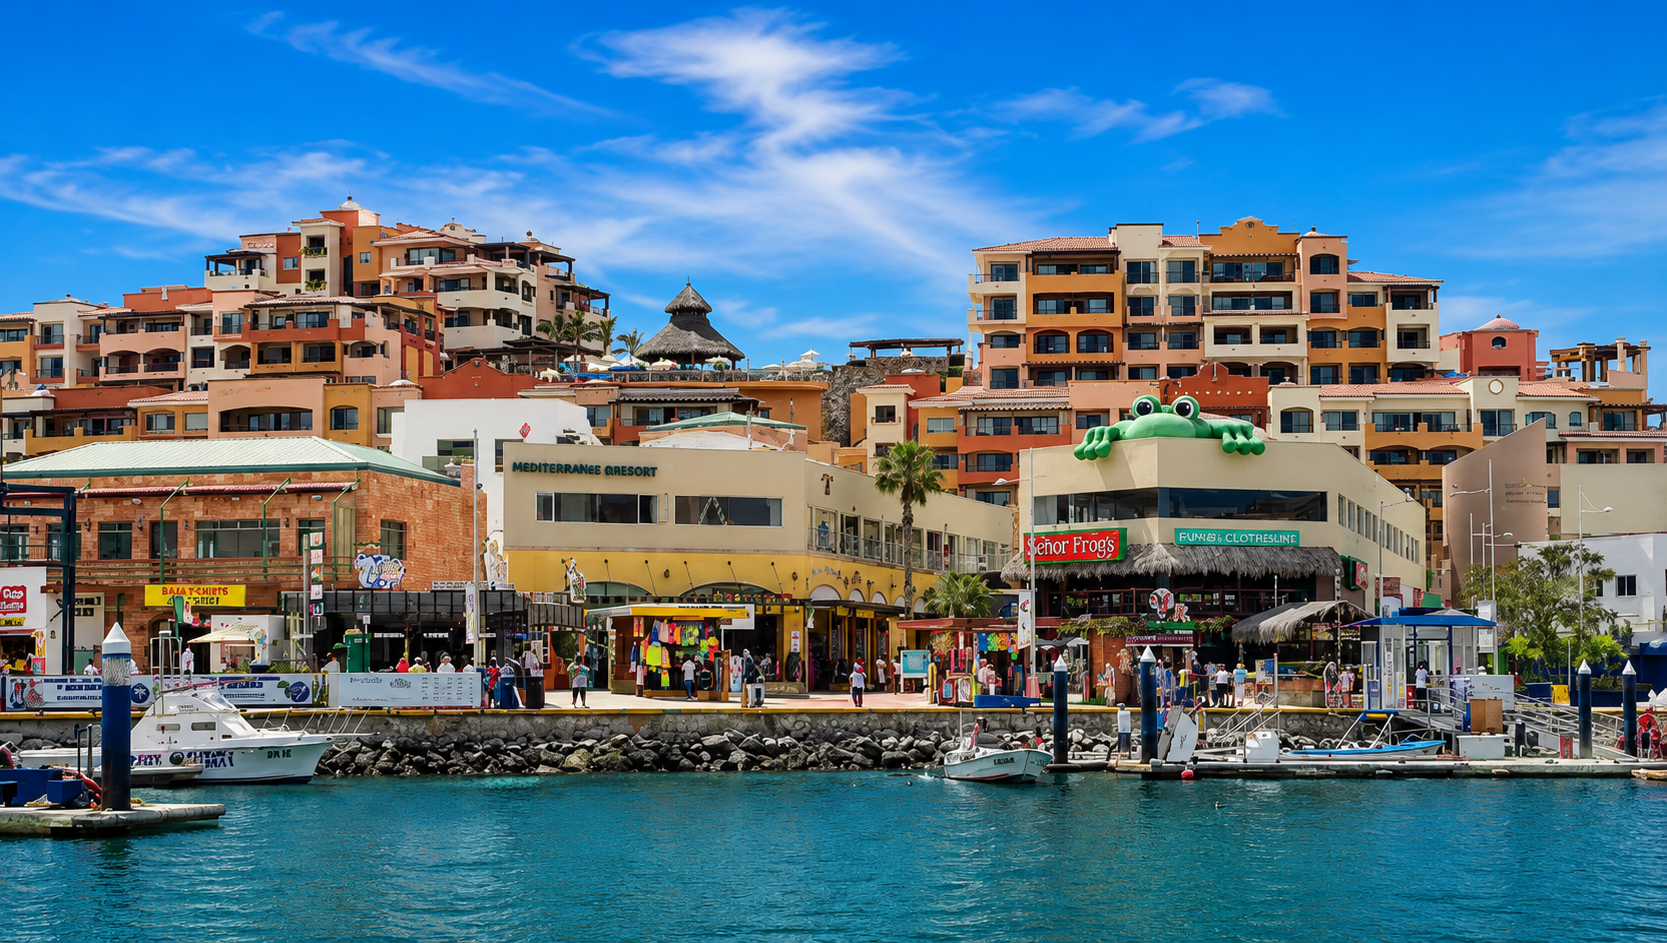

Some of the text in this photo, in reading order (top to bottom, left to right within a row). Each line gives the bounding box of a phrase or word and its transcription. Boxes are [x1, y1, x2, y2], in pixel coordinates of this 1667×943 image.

[512, 461, 601, 475] MEDITERRANEE
[1027, 536, 1115, 559] Señor Frog's
